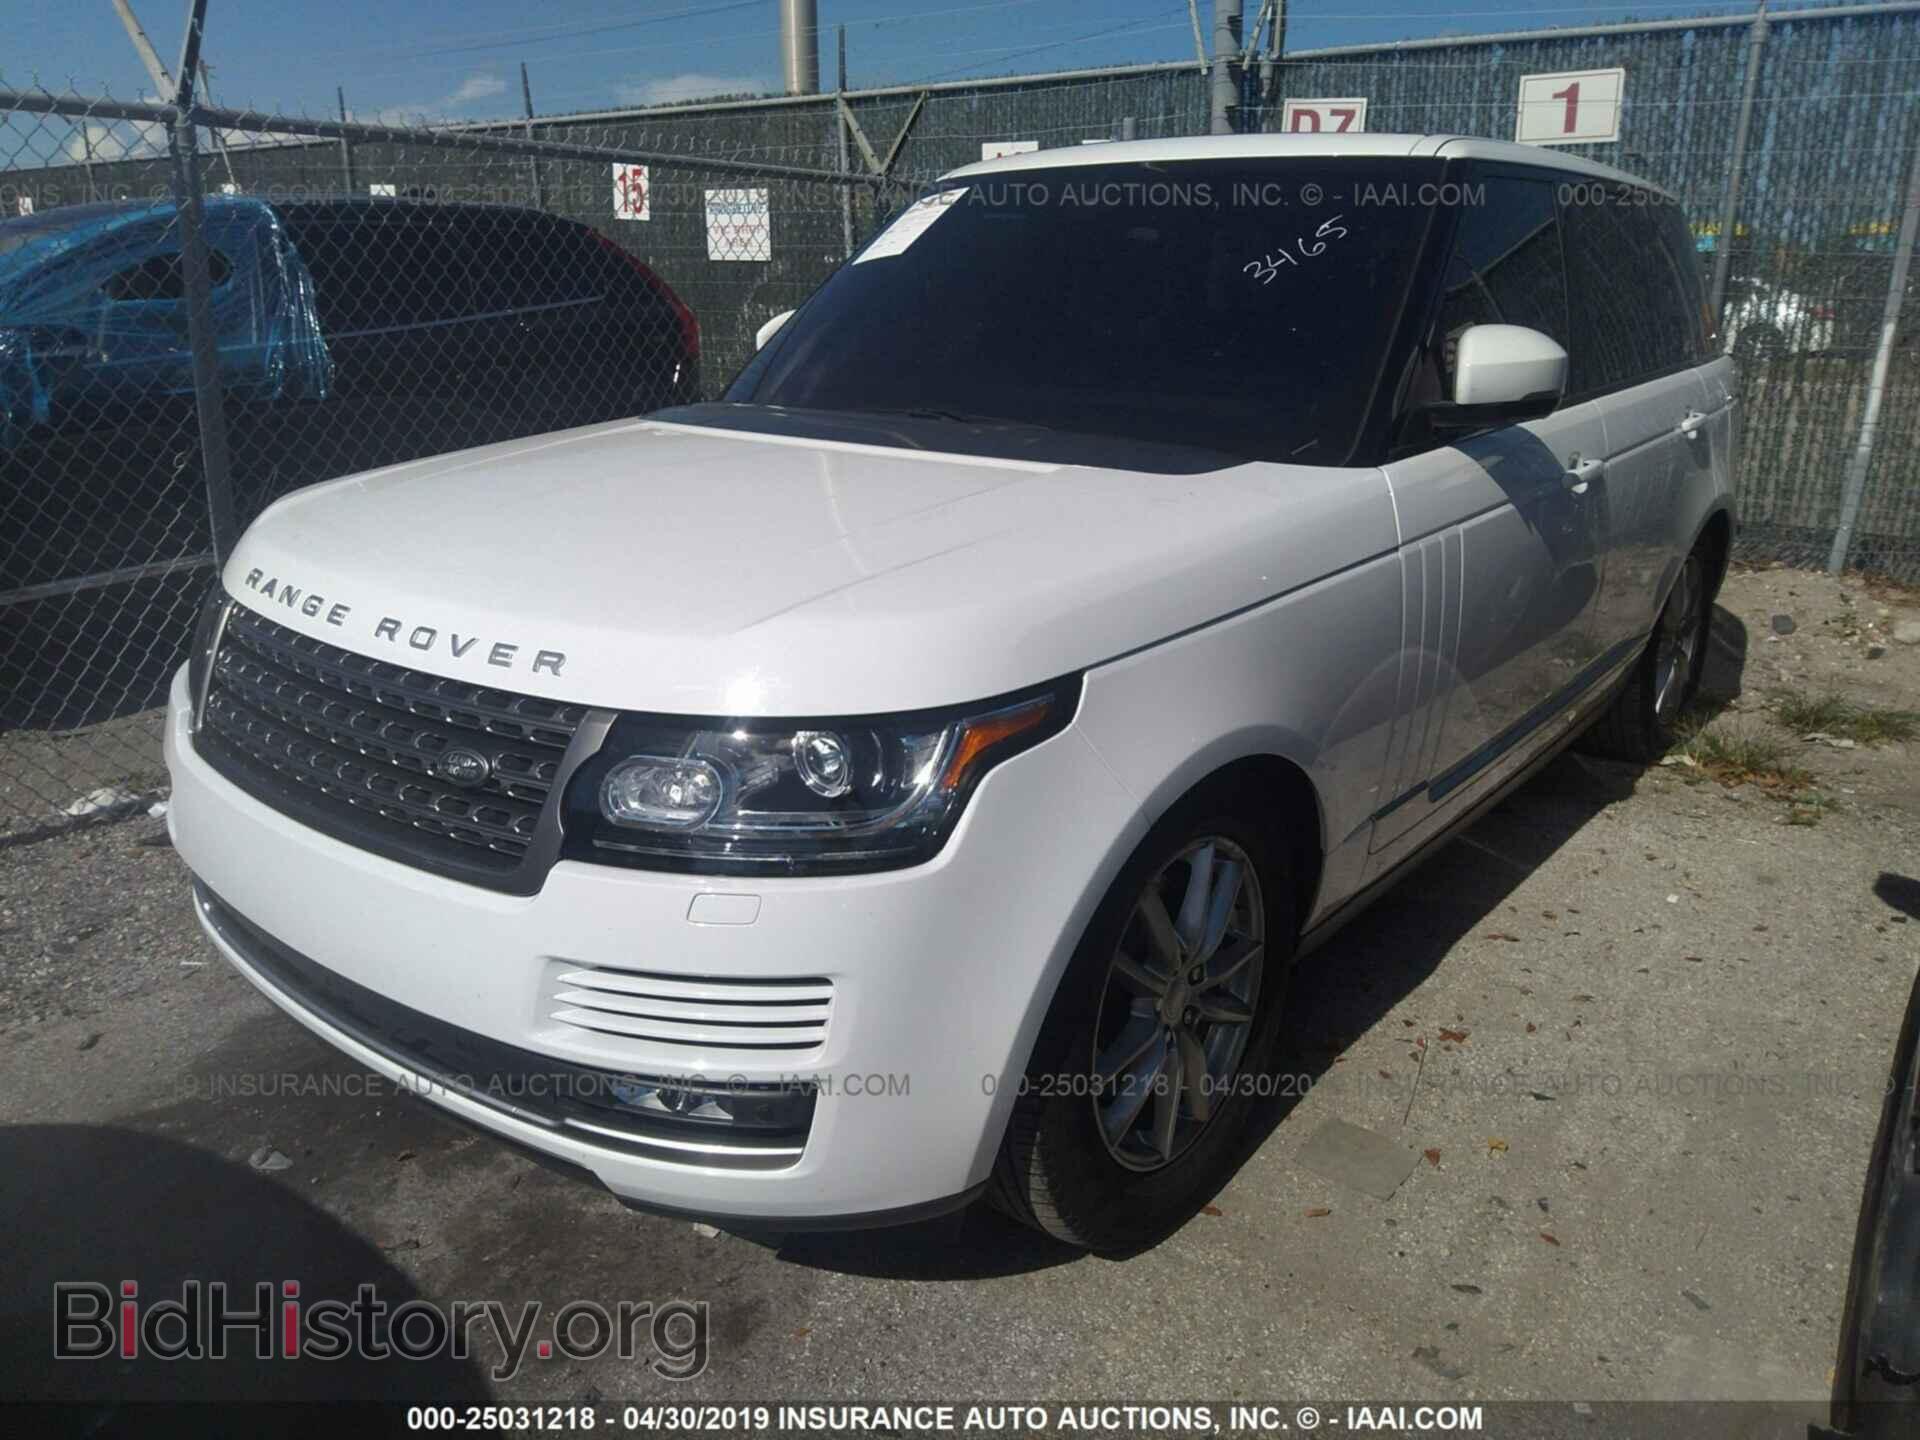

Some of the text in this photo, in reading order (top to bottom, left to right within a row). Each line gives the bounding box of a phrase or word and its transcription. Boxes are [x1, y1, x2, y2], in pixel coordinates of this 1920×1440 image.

[1552, 81, 1580, 133] 1
[618, 169, 644, 213] 15
[1243, 215, 1347, 284] 3465
[245, 568, 567, 677] RANGE ROVER
